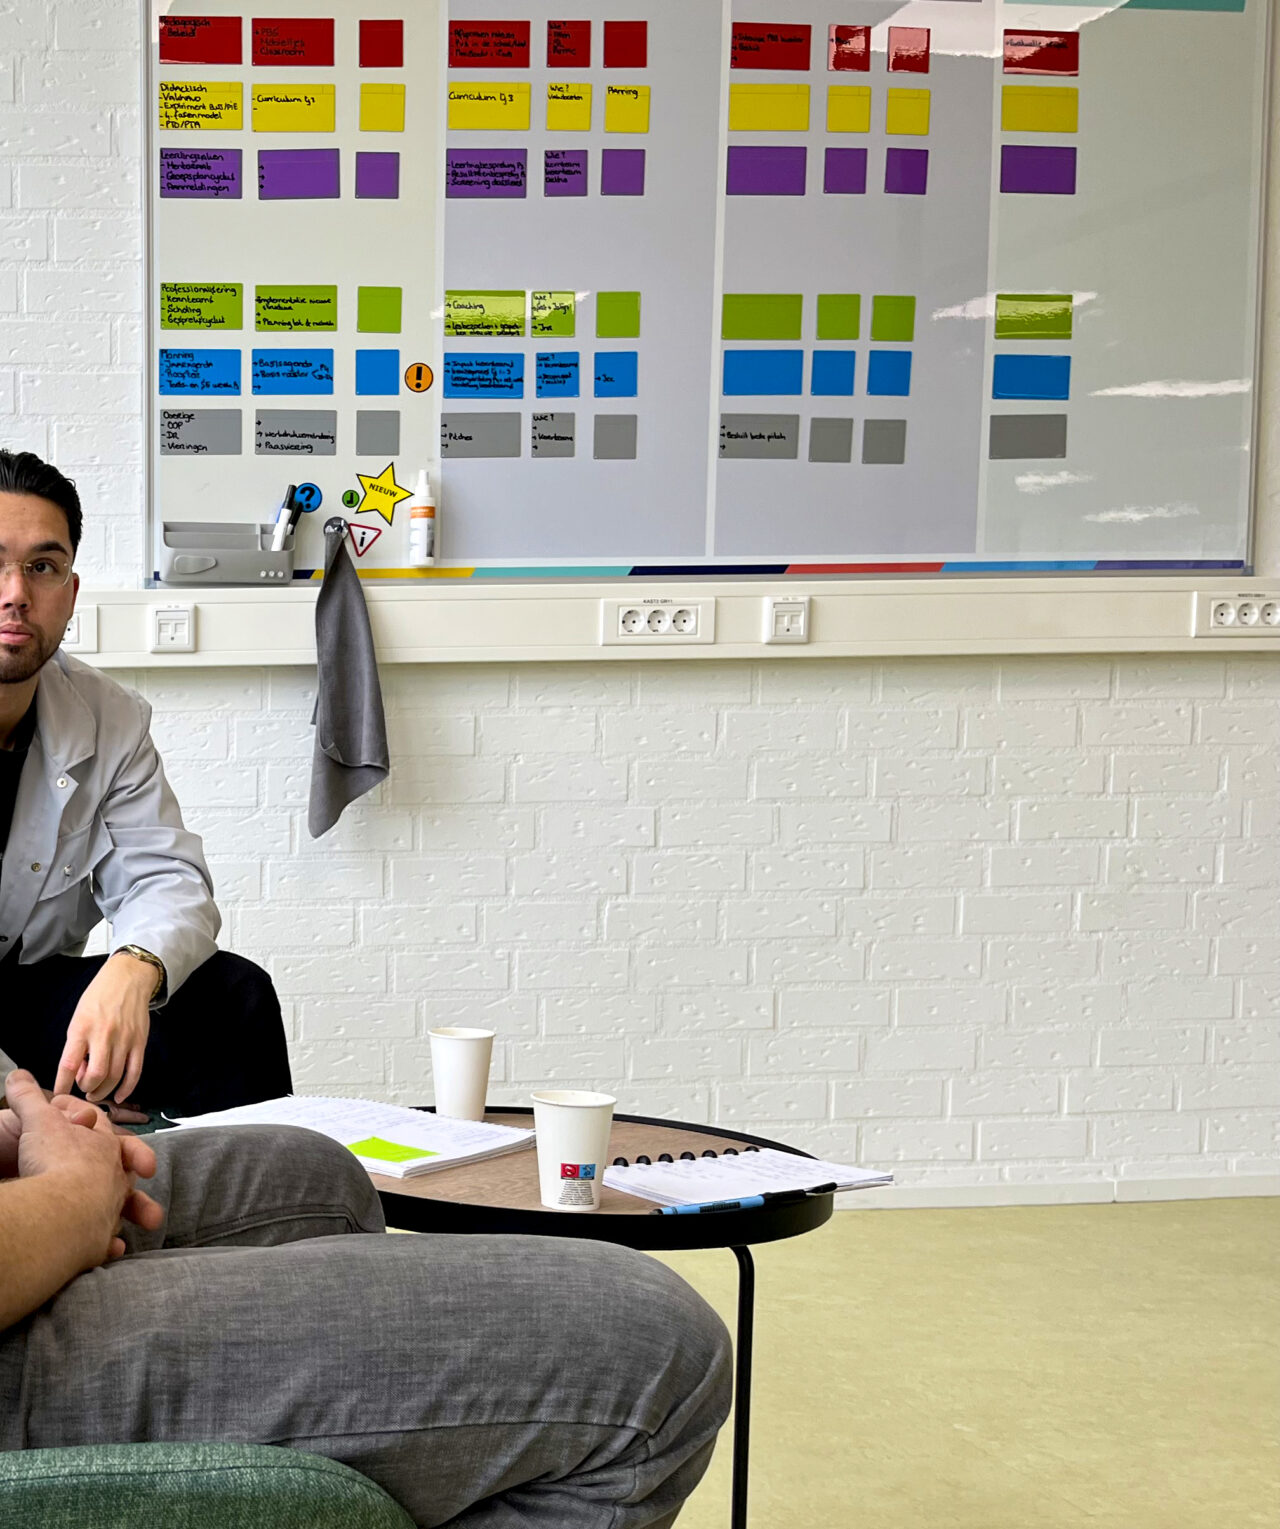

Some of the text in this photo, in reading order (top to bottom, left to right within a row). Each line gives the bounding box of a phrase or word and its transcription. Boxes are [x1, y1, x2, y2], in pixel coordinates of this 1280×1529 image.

[448, 91, 497, 101] Curriculum
[453, 300, 486, 315] Coaching
[369, 482, 398, 498] NIEUW
